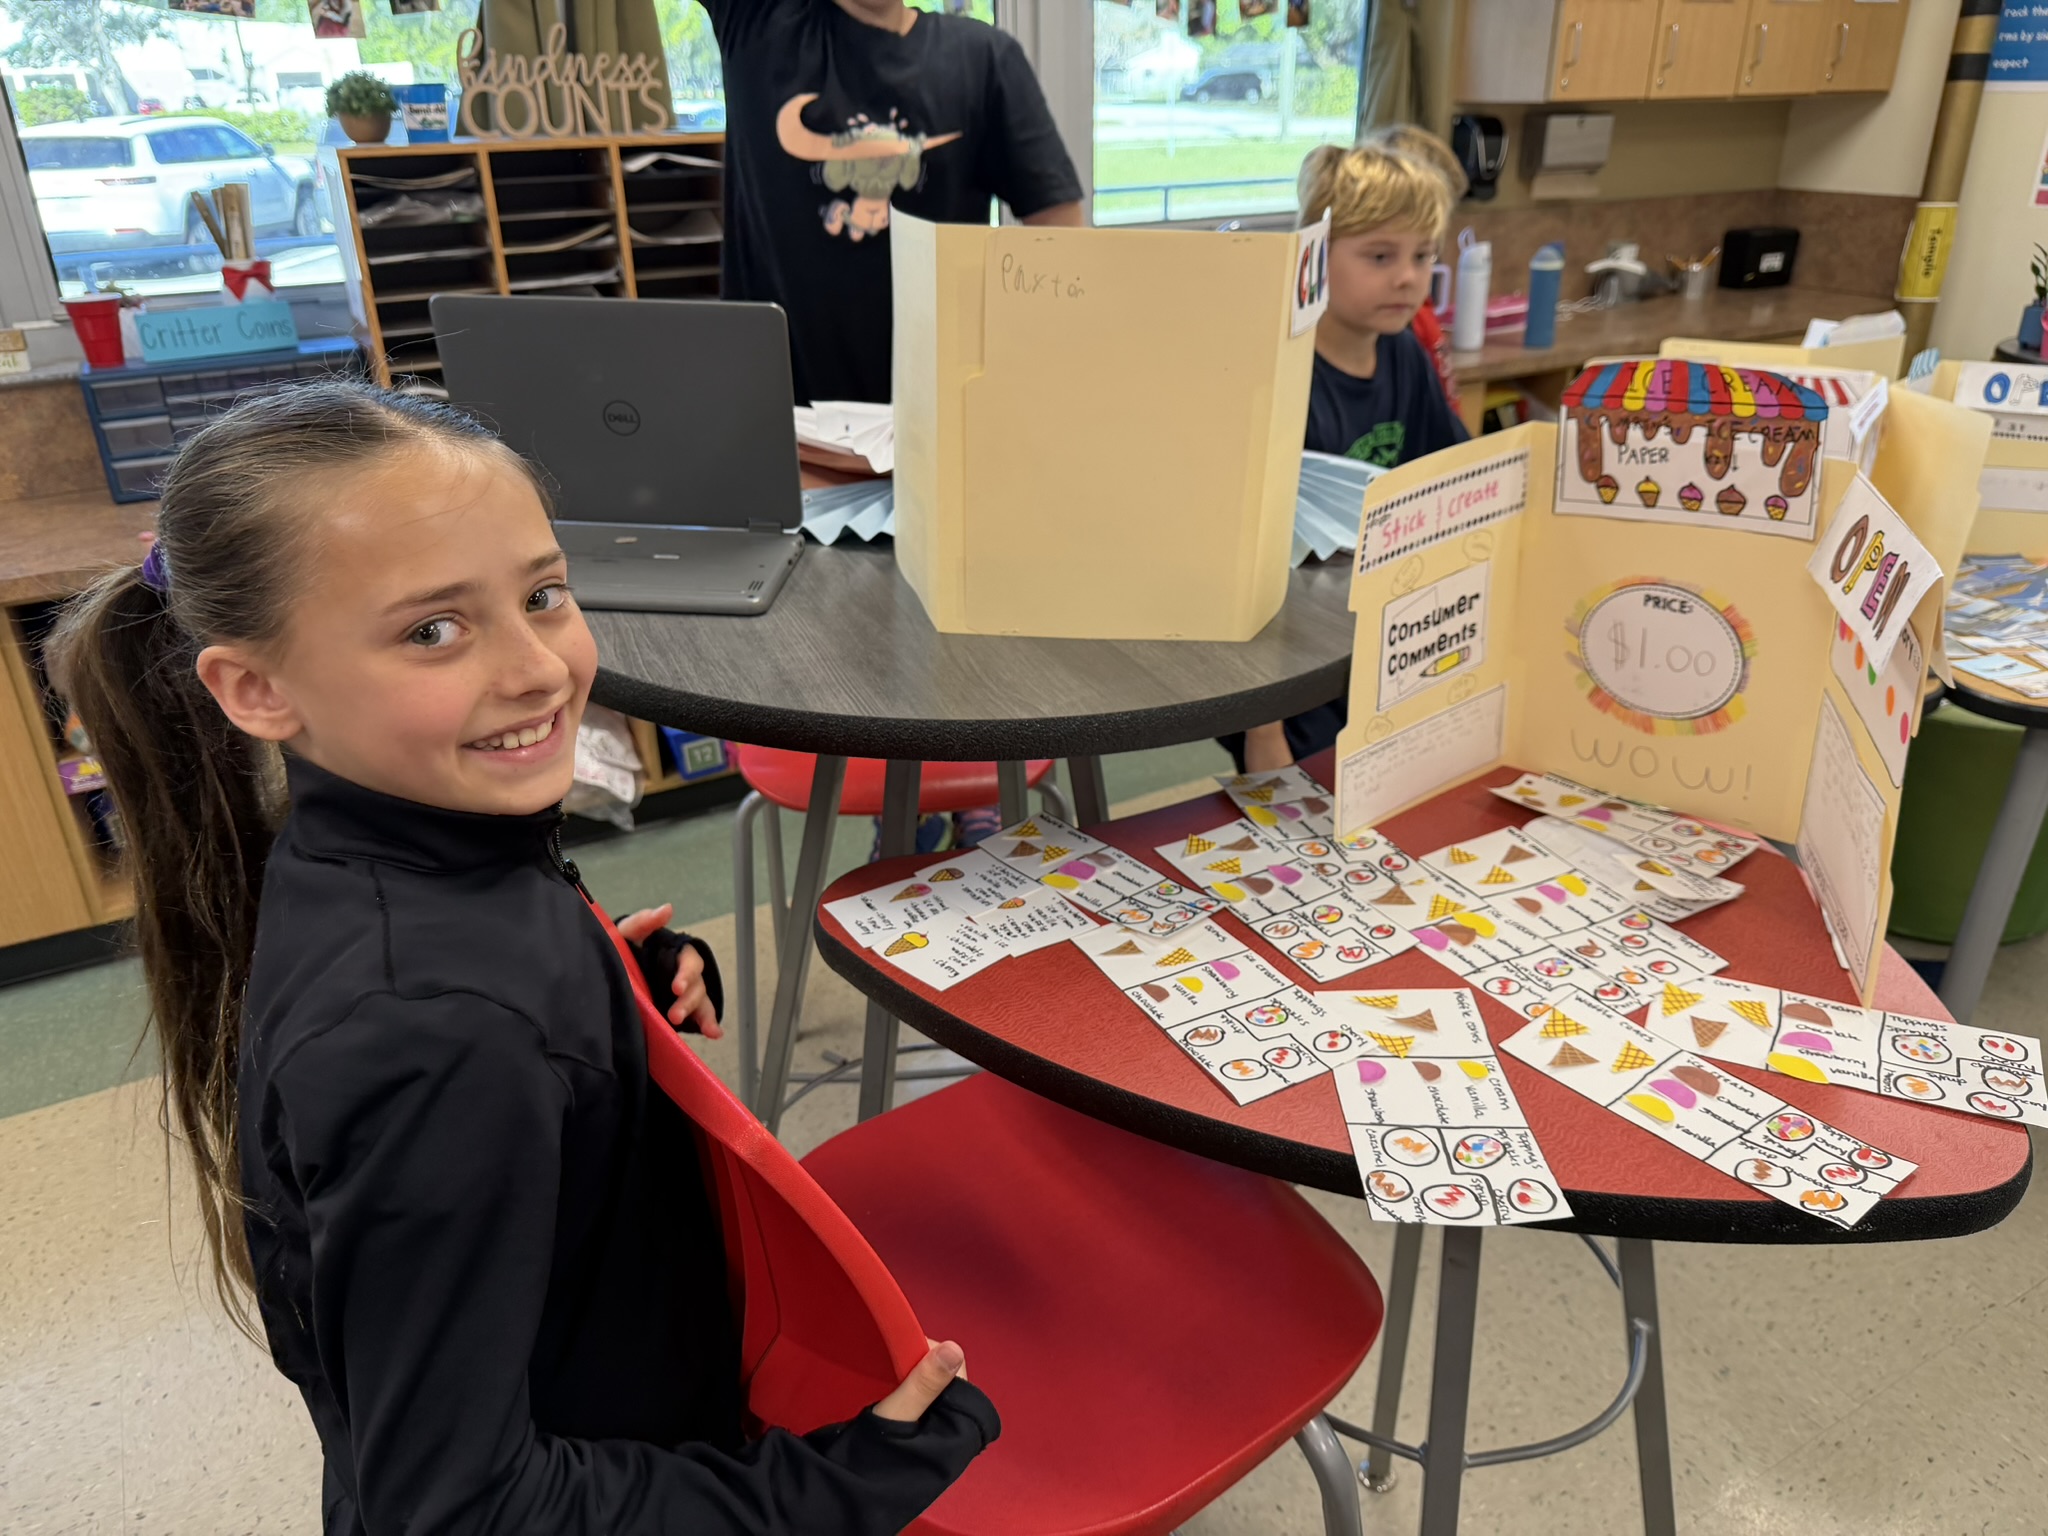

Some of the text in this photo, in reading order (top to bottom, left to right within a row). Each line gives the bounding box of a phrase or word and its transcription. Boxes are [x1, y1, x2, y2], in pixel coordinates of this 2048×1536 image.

[2003, 6, 2028, 17] rack
[1992, 56, 2029, 70] espect
[463, 80, 669, 139] COUNTS
[140, 310, 293, 349] Critter Coins
[1629, 366, 1672, 395] ICE
[607, 413, 638, 424] DELL
[1618, 445, 1669, 465] PAPER
[1608, 620, 1716, 677] $1.00
[1465, 1084, 1490, 1119] vanilla
[1482, 1060, 1510, 1111] ice cream
